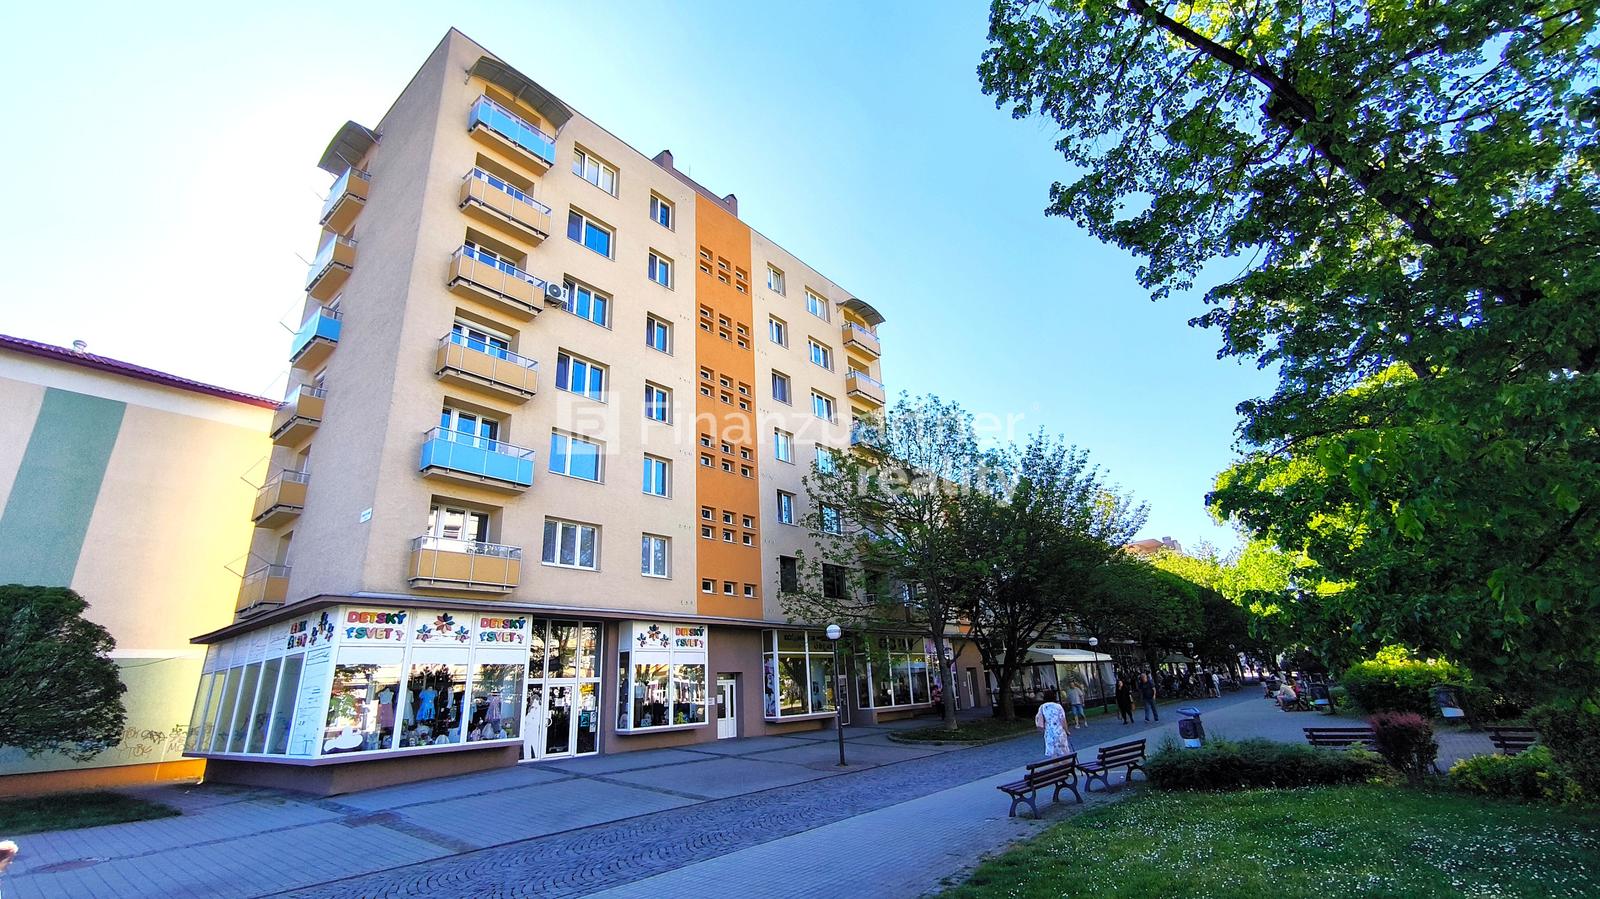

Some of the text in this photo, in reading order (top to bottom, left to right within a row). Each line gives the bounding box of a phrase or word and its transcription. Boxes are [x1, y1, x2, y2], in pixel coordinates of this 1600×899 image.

[347, 610, 406, 624] DETSKÝ
[480, 616, 526, 629] DETSKÝ
[355, 627, 393, 639] SVET
[486, 631, 516, 642] SVET
